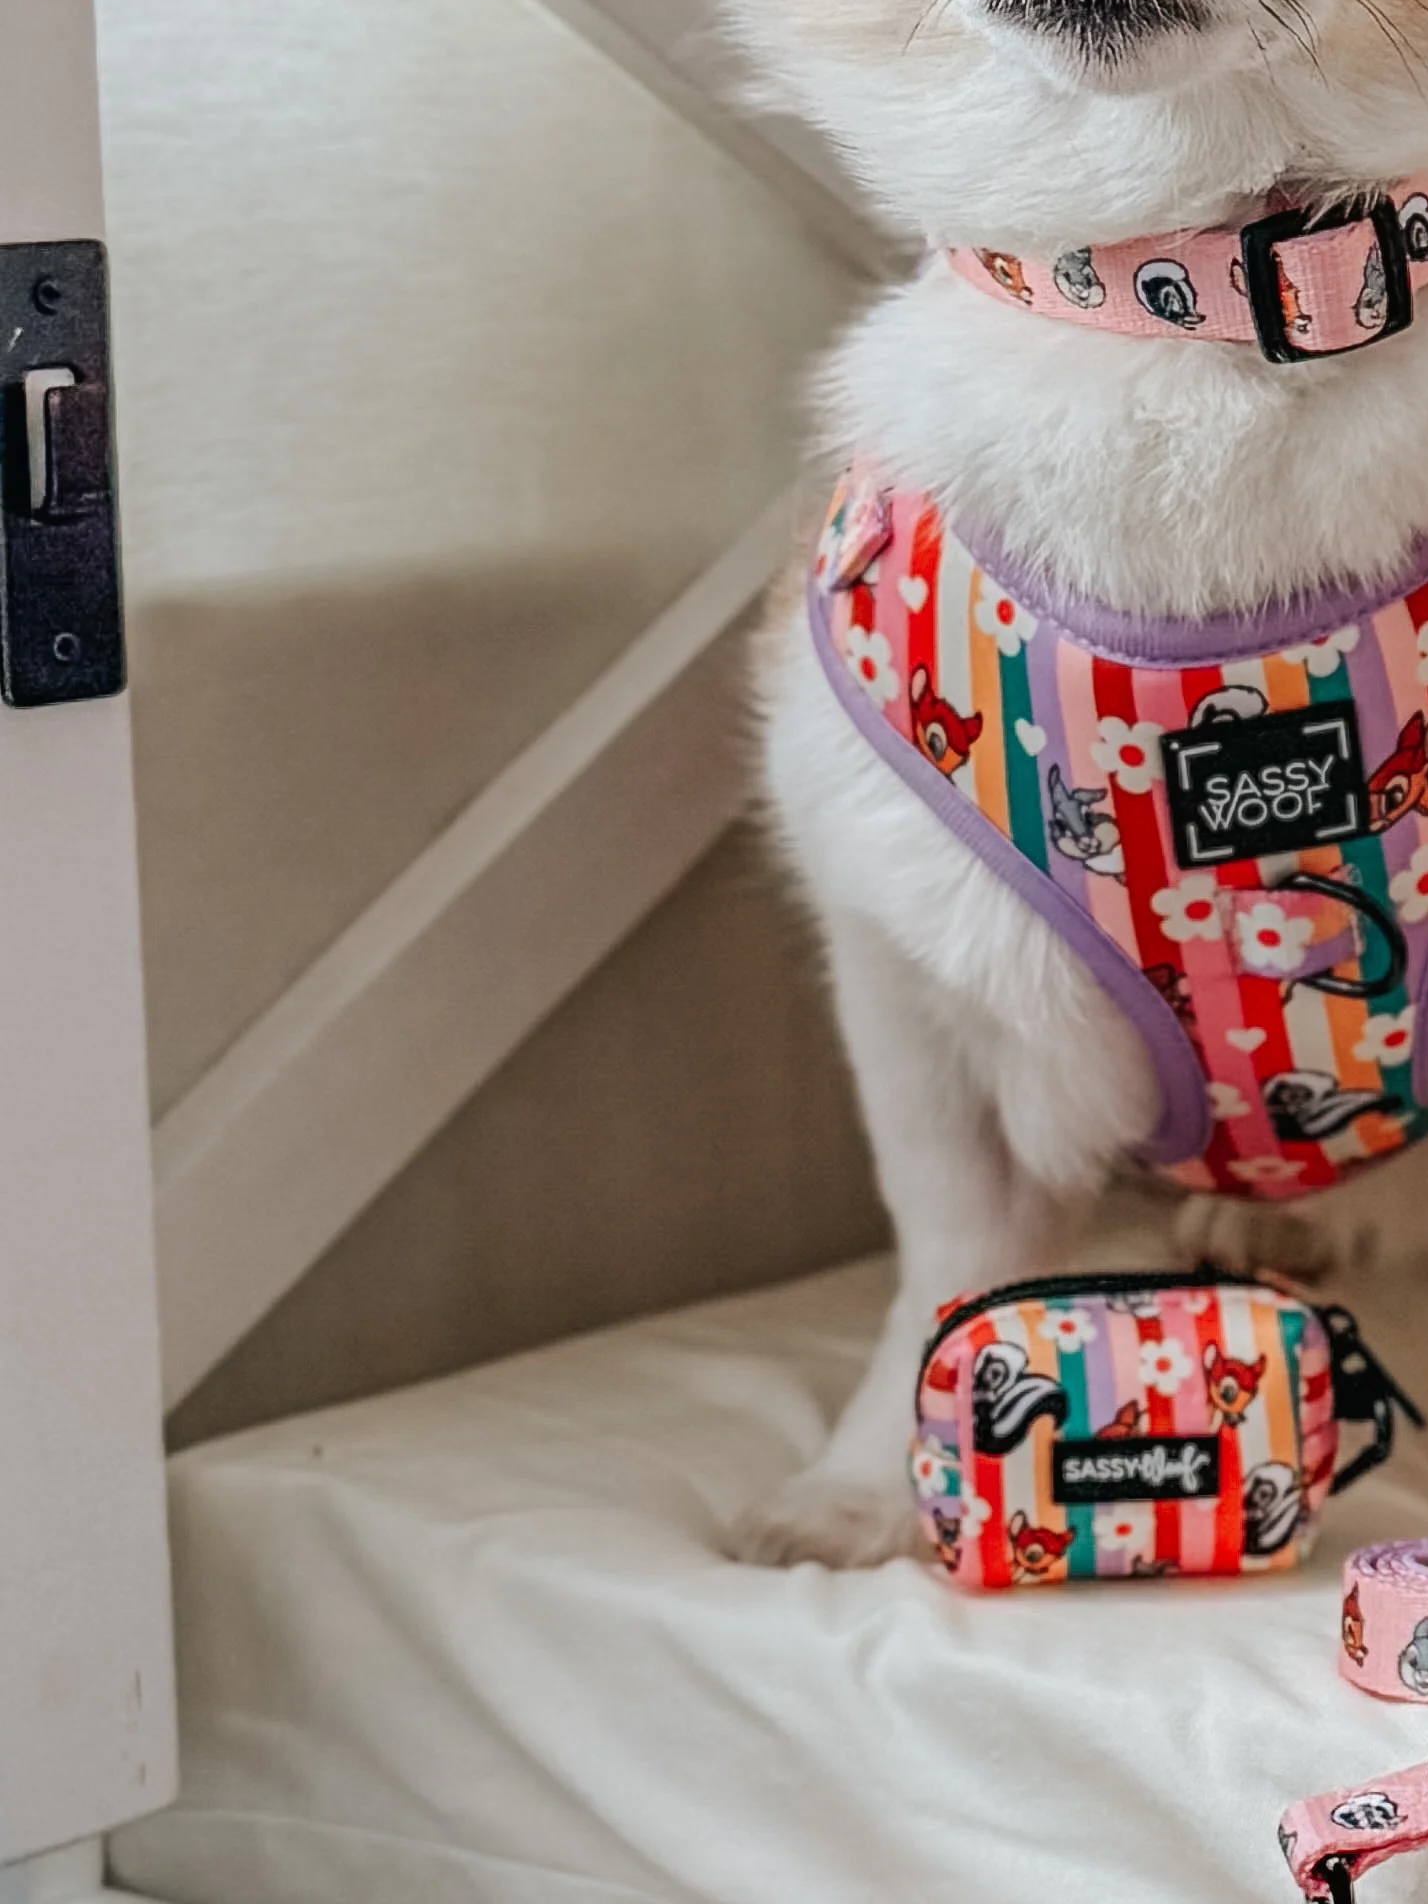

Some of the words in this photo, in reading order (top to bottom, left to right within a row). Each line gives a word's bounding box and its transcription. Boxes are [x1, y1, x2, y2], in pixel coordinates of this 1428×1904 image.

[1205, 754, 1335, 806] SASSY
[1200, 783, 1330, 831] WOOF
[1064, 1456, 1140, 1482] SASSY
